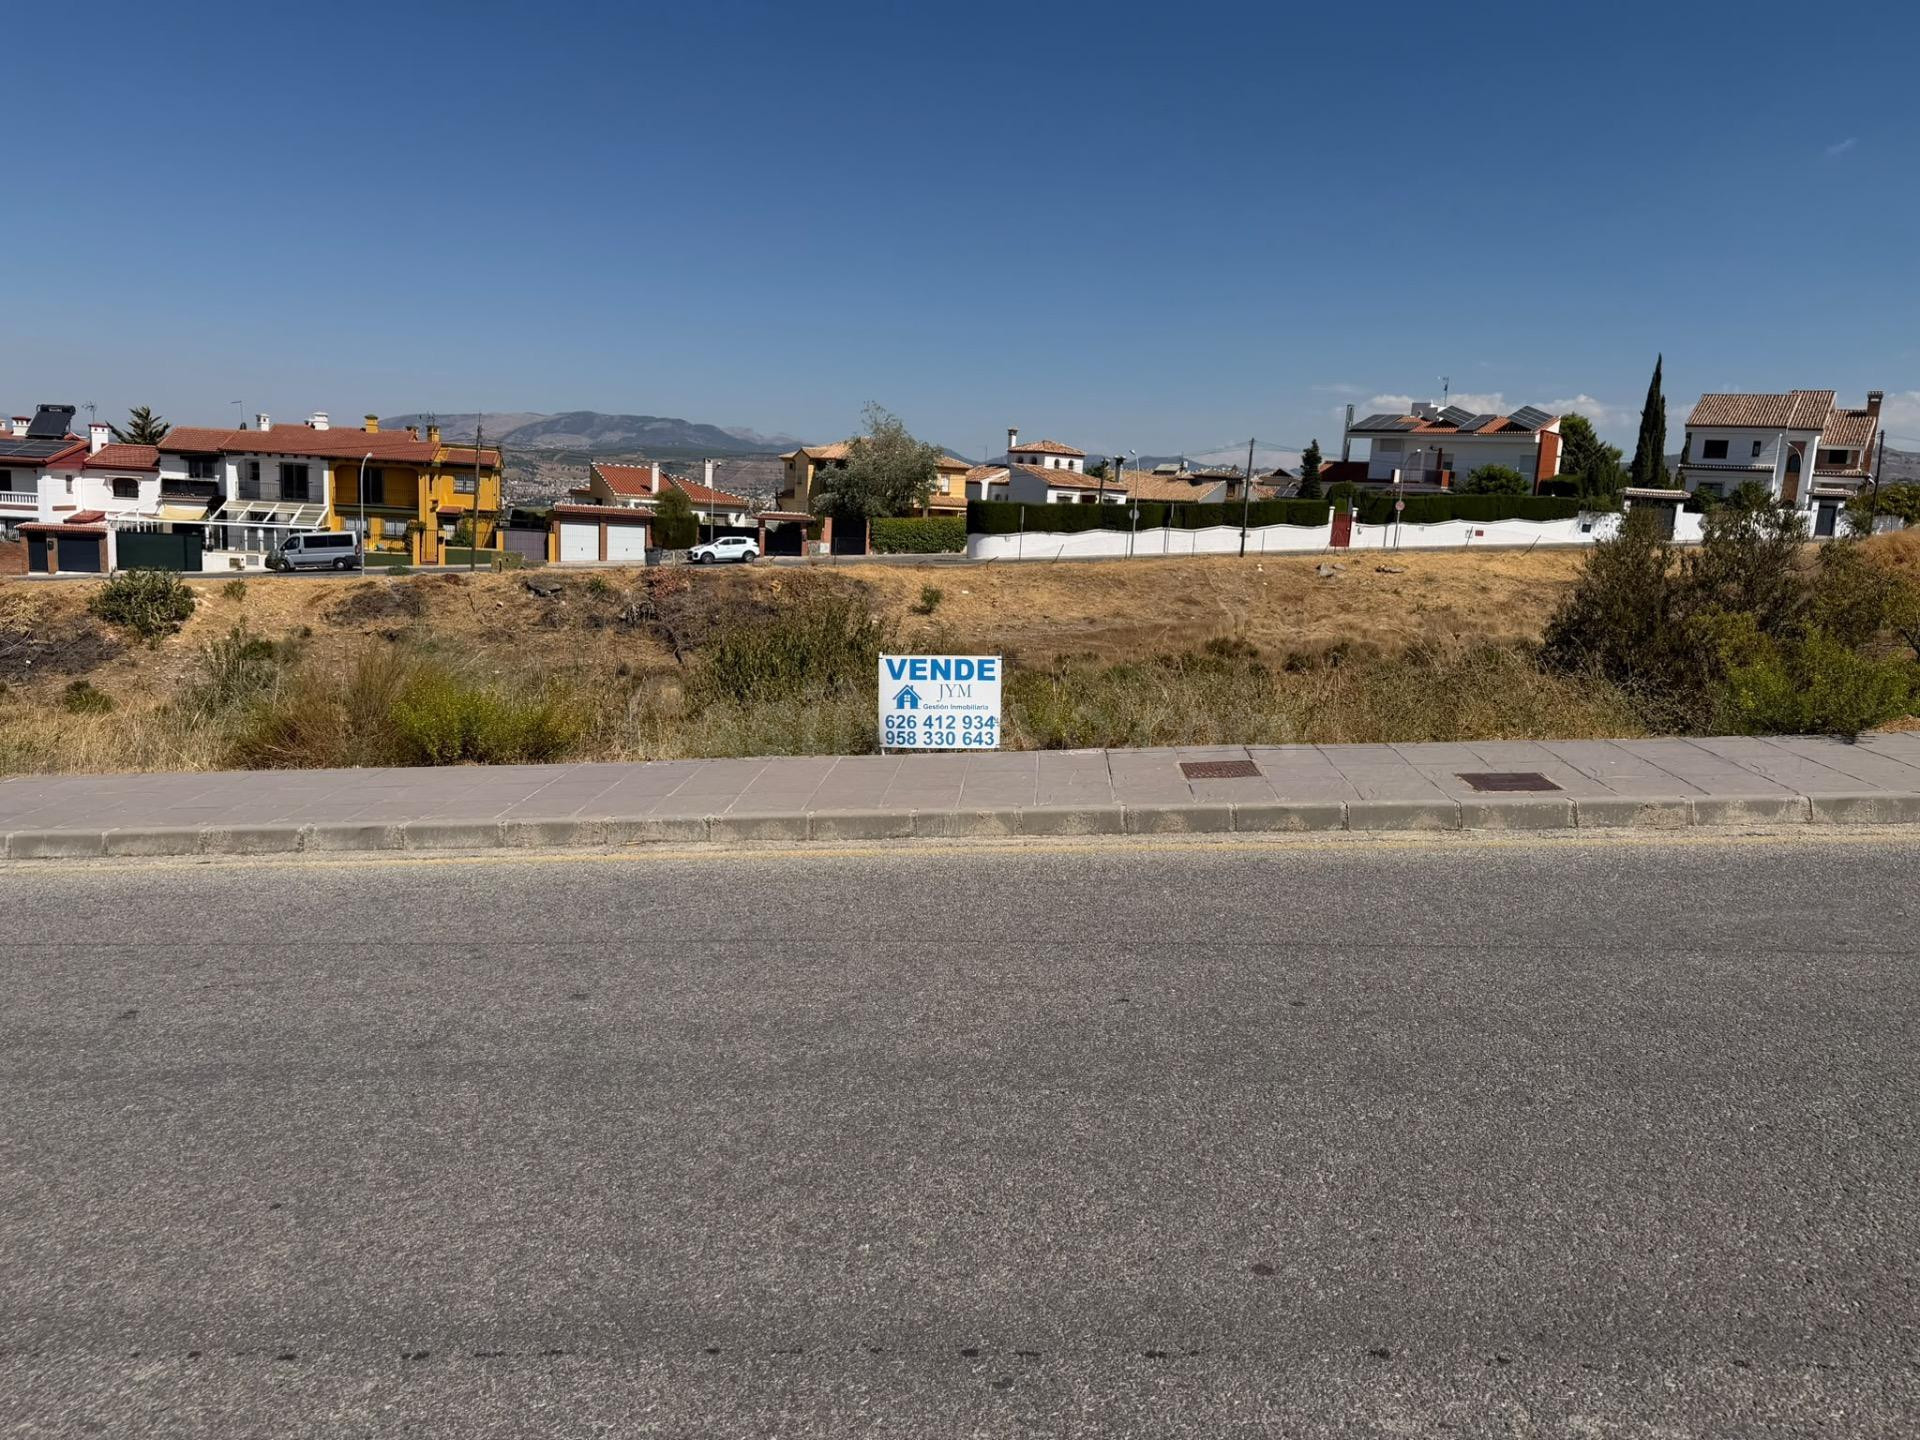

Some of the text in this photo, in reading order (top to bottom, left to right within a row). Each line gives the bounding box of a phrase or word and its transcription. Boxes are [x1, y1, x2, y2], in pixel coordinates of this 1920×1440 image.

[886, 659, 996, 680] VENDE
[936, 684, 972, 702] JYM
[885, 715, 995, 730] 626 412 934
[885, 731, 994, 746] 958 330 643
